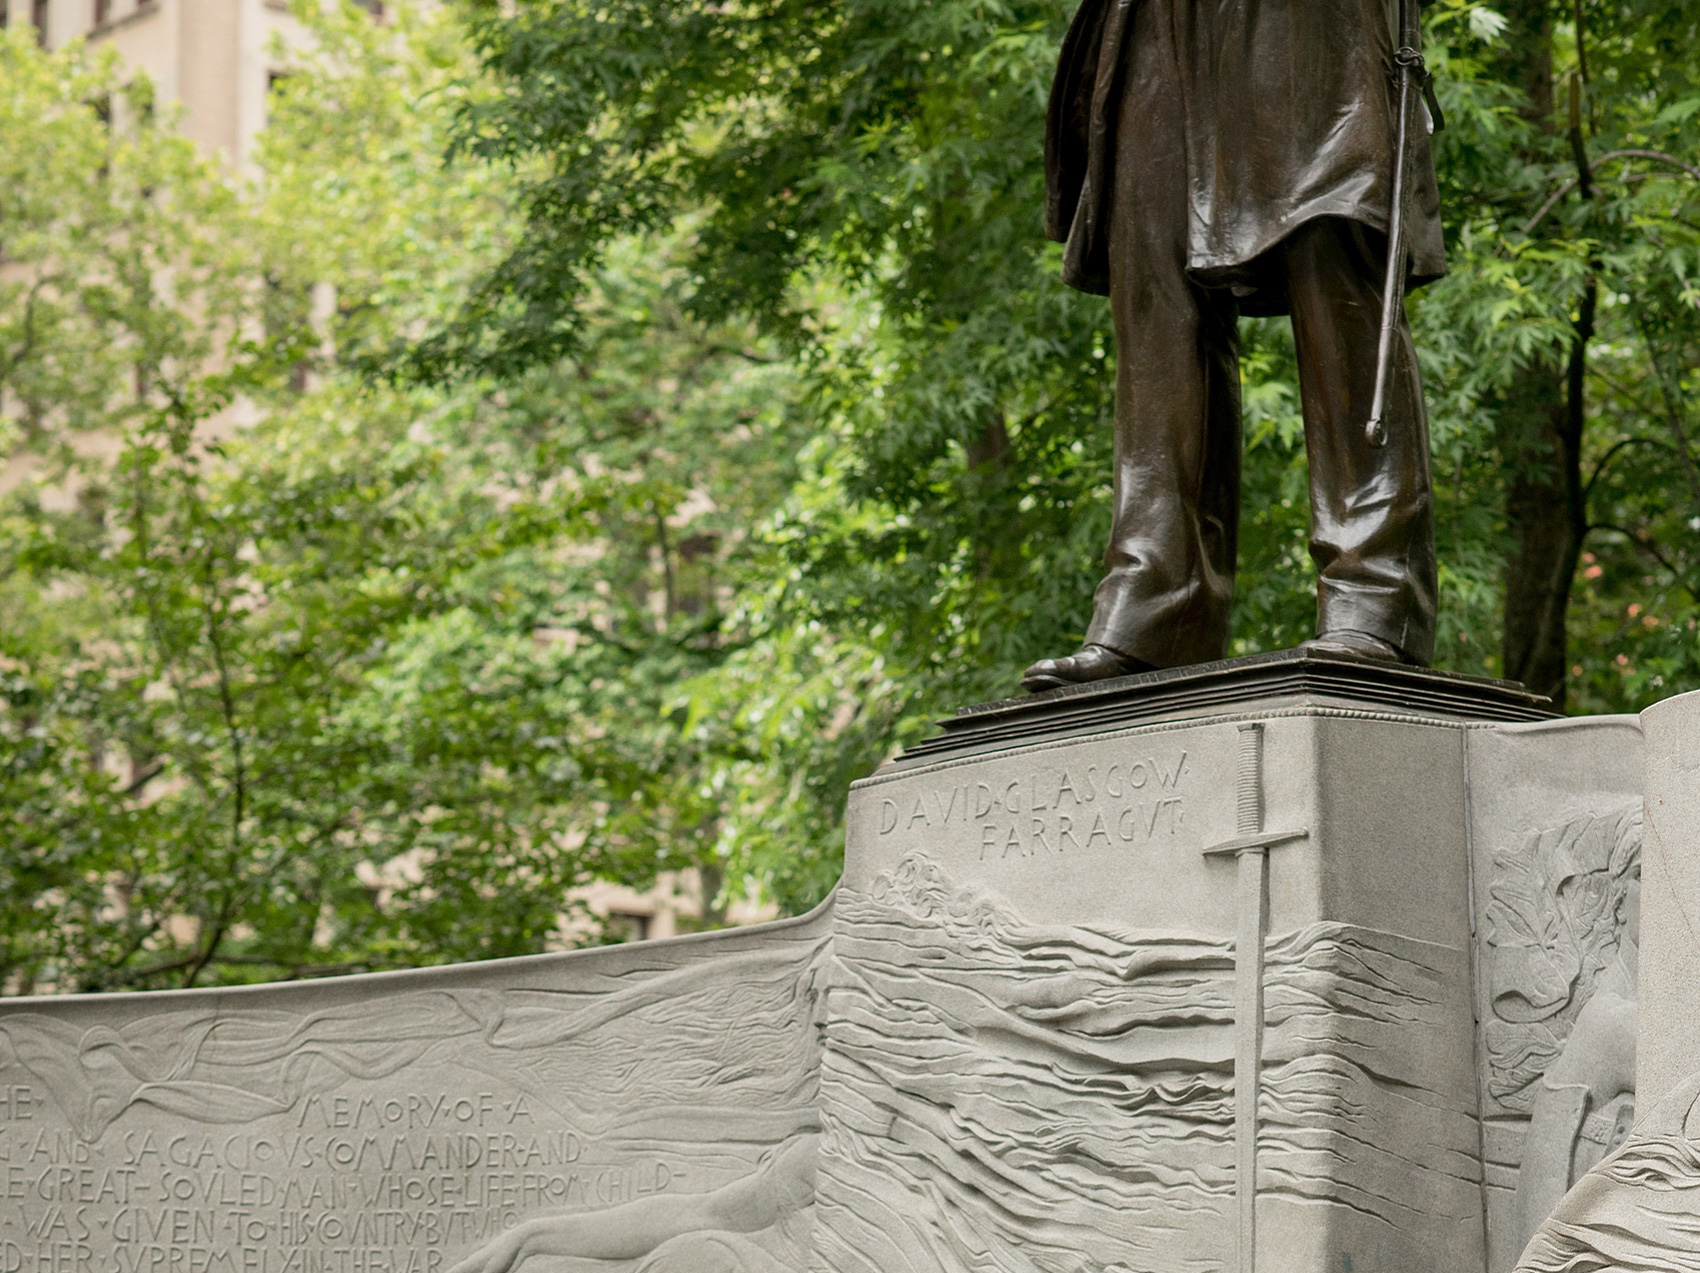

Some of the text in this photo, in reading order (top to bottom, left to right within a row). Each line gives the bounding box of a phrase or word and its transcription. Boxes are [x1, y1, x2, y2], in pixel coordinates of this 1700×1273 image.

[879, 750, 1188, 836] DAVID GLASGOW
[297, 1093, 446, 1129] MEMORY
[454, 1092, 493, 1127] OF
[507, 1093, 535, 1125] A
[522, 1130, 583, 1168] AND
[361, 1173, 457, 1209] WHOSE
[463, 1173, 516, 1208] LIFE
[18, 1203, 91, 1241] WAS
[112, 1205, 216, 1244] GIVEN
[227, 1209, 267, 1246] TO
[279, 1209, 310, 1246] HIS
